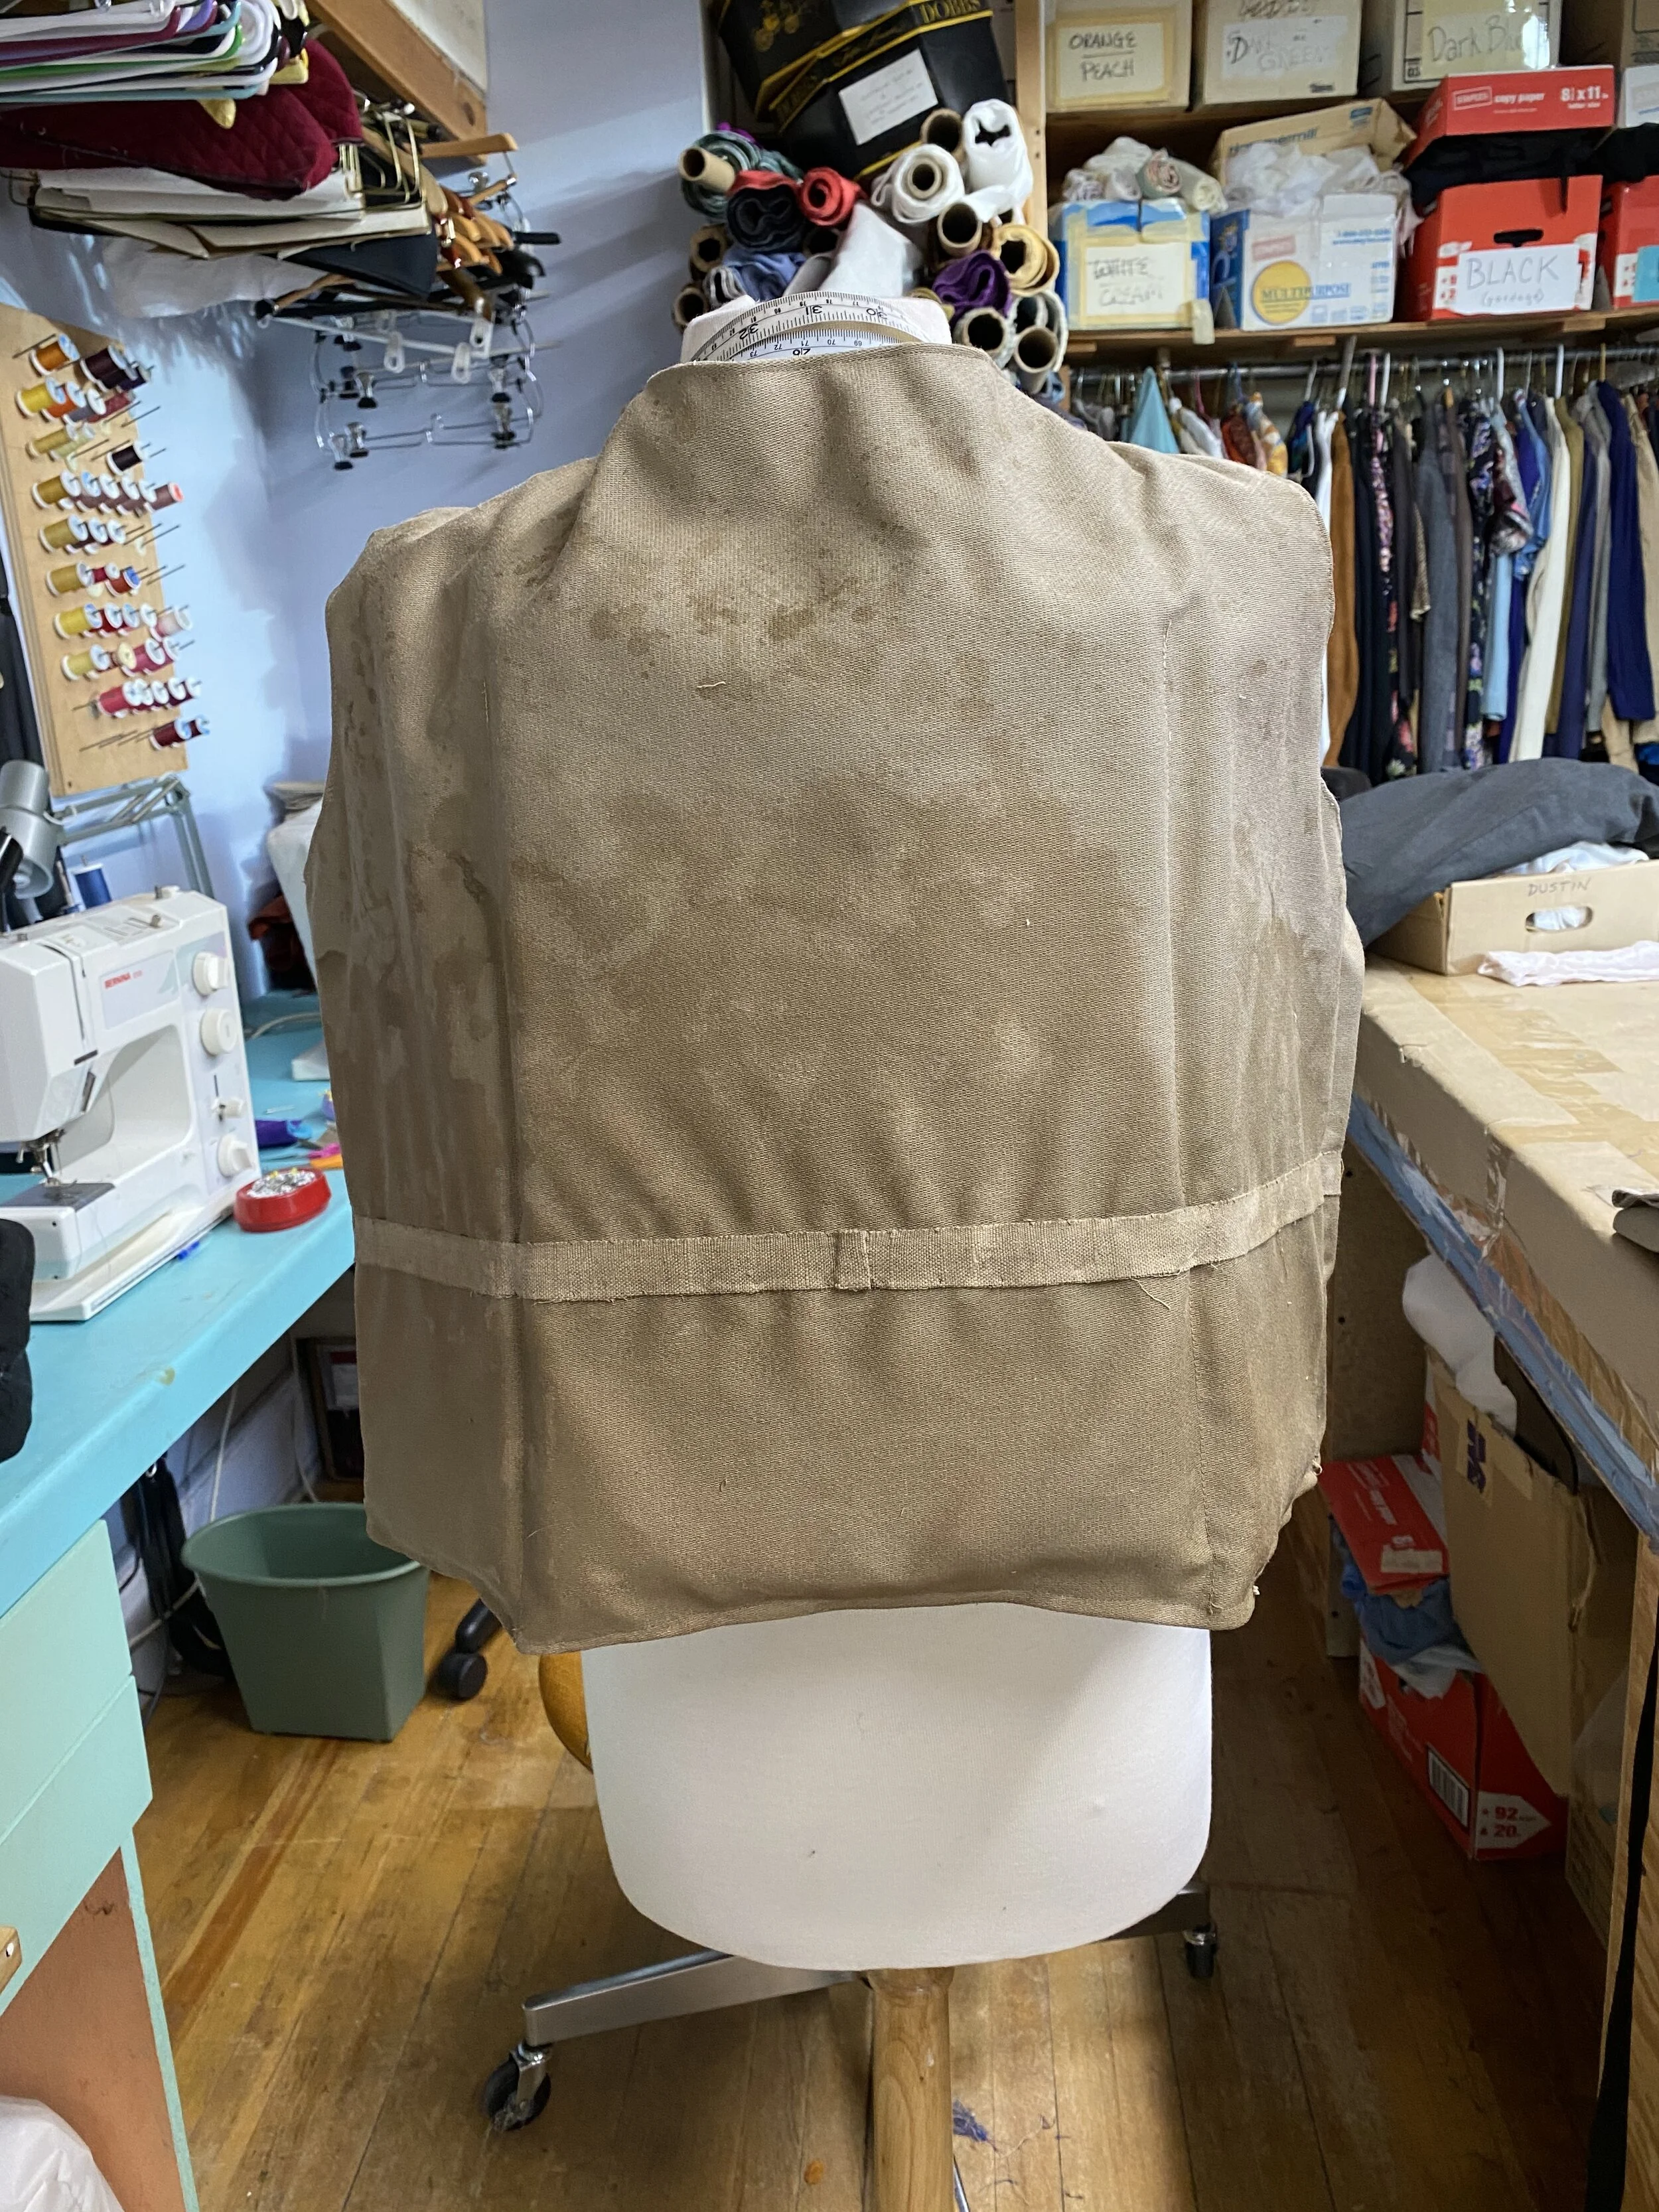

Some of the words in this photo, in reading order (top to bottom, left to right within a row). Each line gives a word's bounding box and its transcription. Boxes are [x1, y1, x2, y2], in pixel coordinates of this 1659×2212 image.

[1068, 31, 1138, 50] ORANGE
[1428, 26, 1482, 62] Dark
[1080, 58, 1134, 81] PEACH
[1467, 255, 1559, 290] BLACK
[805, 305, 823, 316] 31
[739, 323, 759, 340] 32
[1528, 877, 1591, 897] DUSTIN
[1494, 1806, 1518, 1821] 92
[1494, 1824, 1517, 1838] 20
